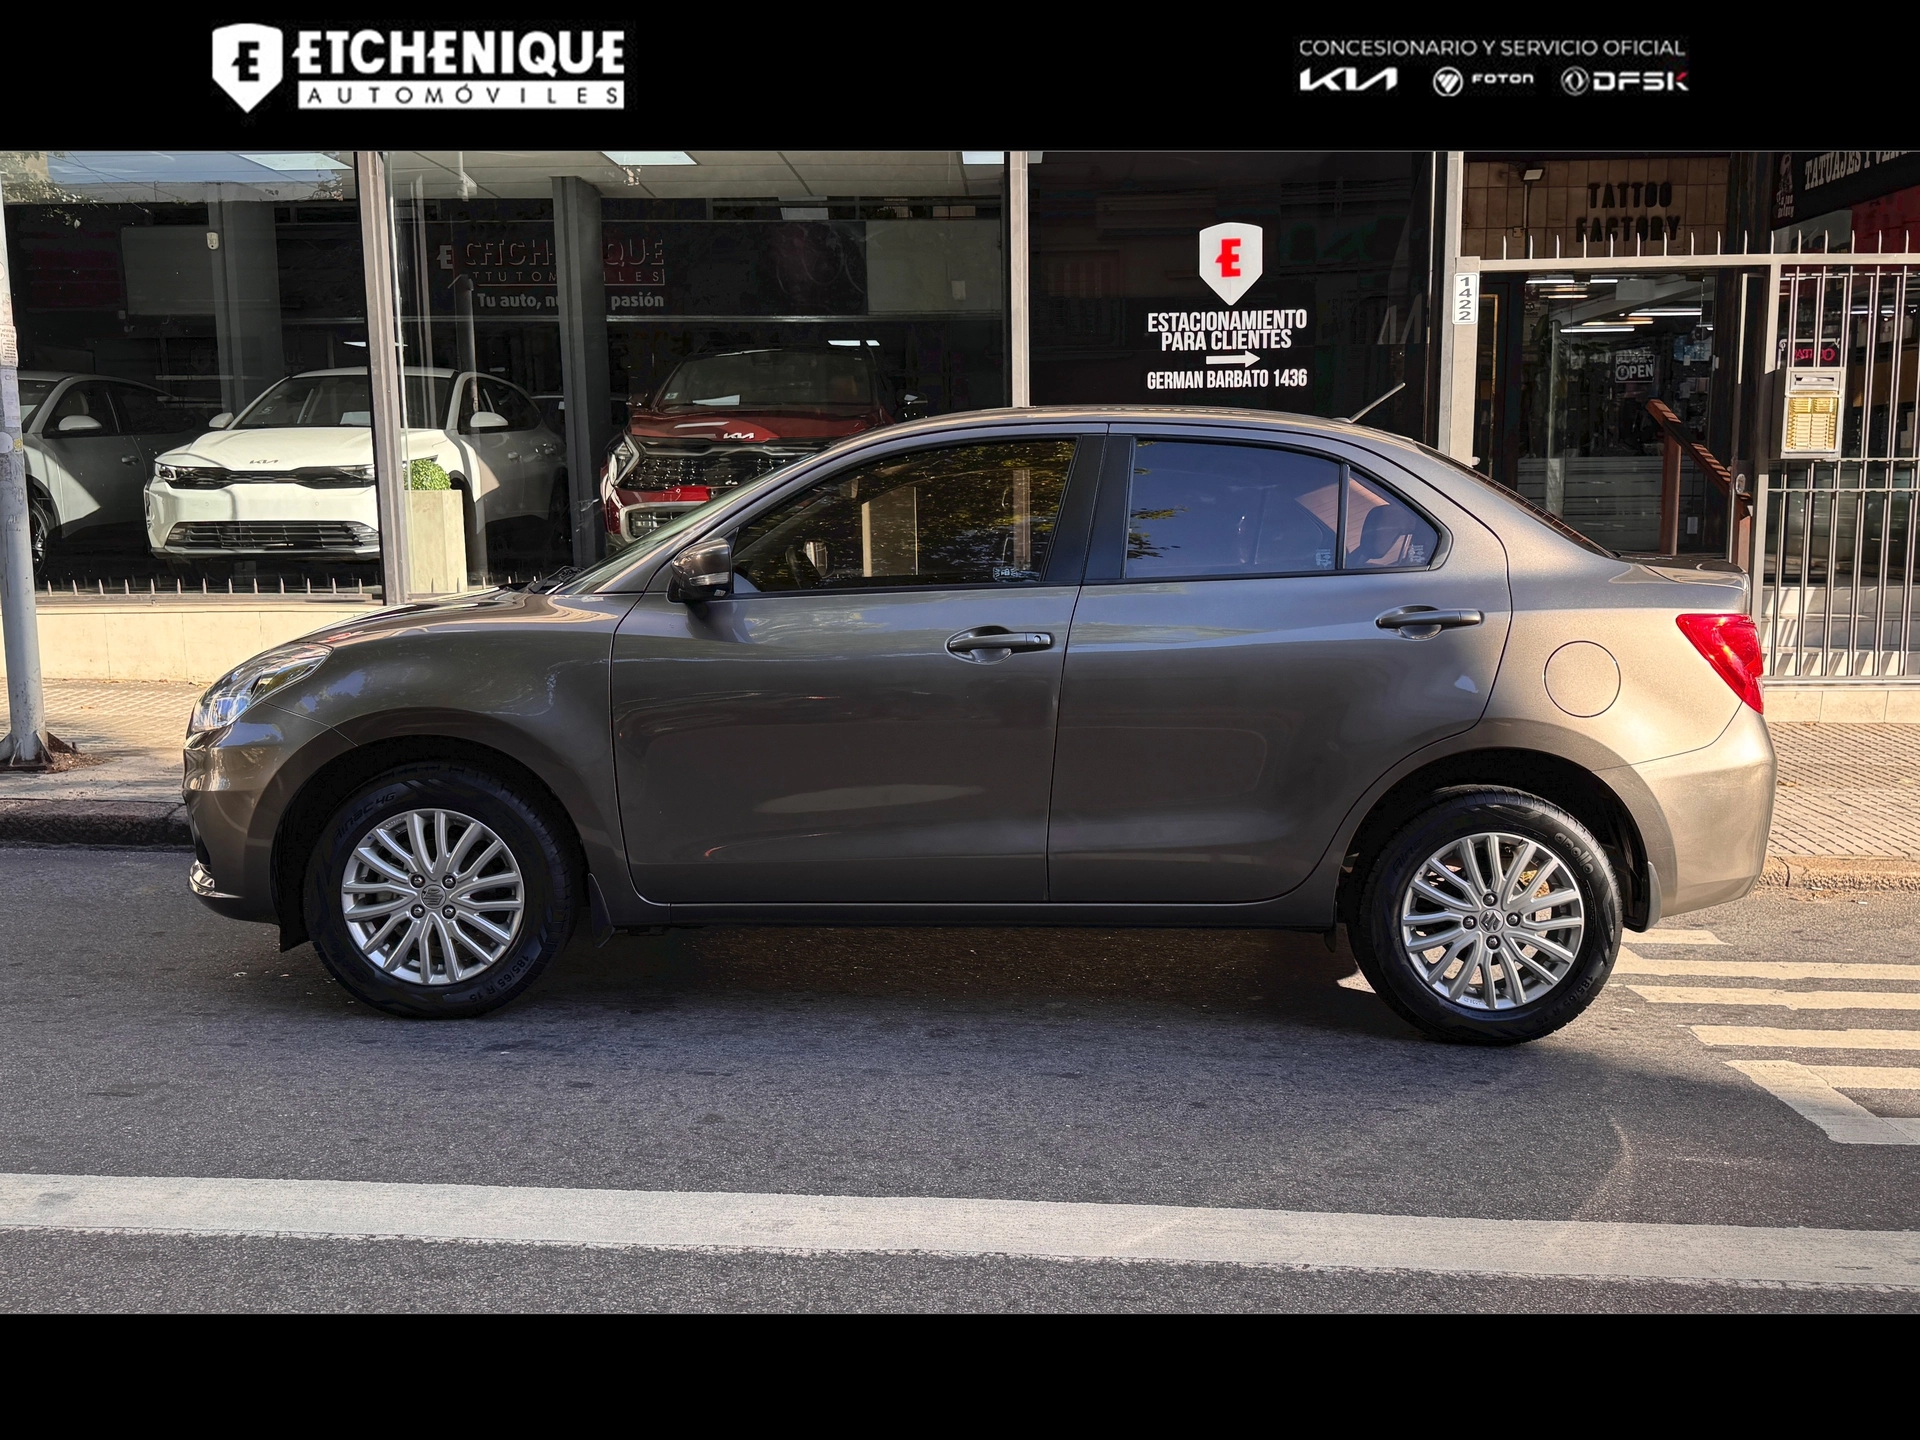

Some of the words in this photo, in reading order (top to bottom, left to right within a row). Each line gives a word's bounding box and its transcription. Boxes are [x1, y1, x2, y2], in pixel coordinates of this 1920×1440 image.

[1587, 182, 1672, 208] TATTOO
[1576, 215, 1681, 242] FACTORY
[477, 293, 496, 307] Tu
[499, 293, 541, 310] auto,
[611, 291, 664, 310] pasión
[1458, 276, 1473, 321] 1422
[1147, 308, 1308, 333] ESTACIONAMIENTO
[1161, 331, 1207, 351] PARA
[1210, 329, 1292, 350] CLIENTES
[1147, 370, 1204, 390] GERMAN
[1206, 369, 1269, 389] BARBATO
[1273, 368, 1308, 388] 1436
[1616, 363, 1654, 381] OPEN
[1554, 832, 1594, 874] apollo
[496, 954, 529, 988] 185/65
[469, 991, 484, 1003] 15
[486, 985, 496, 995] R
